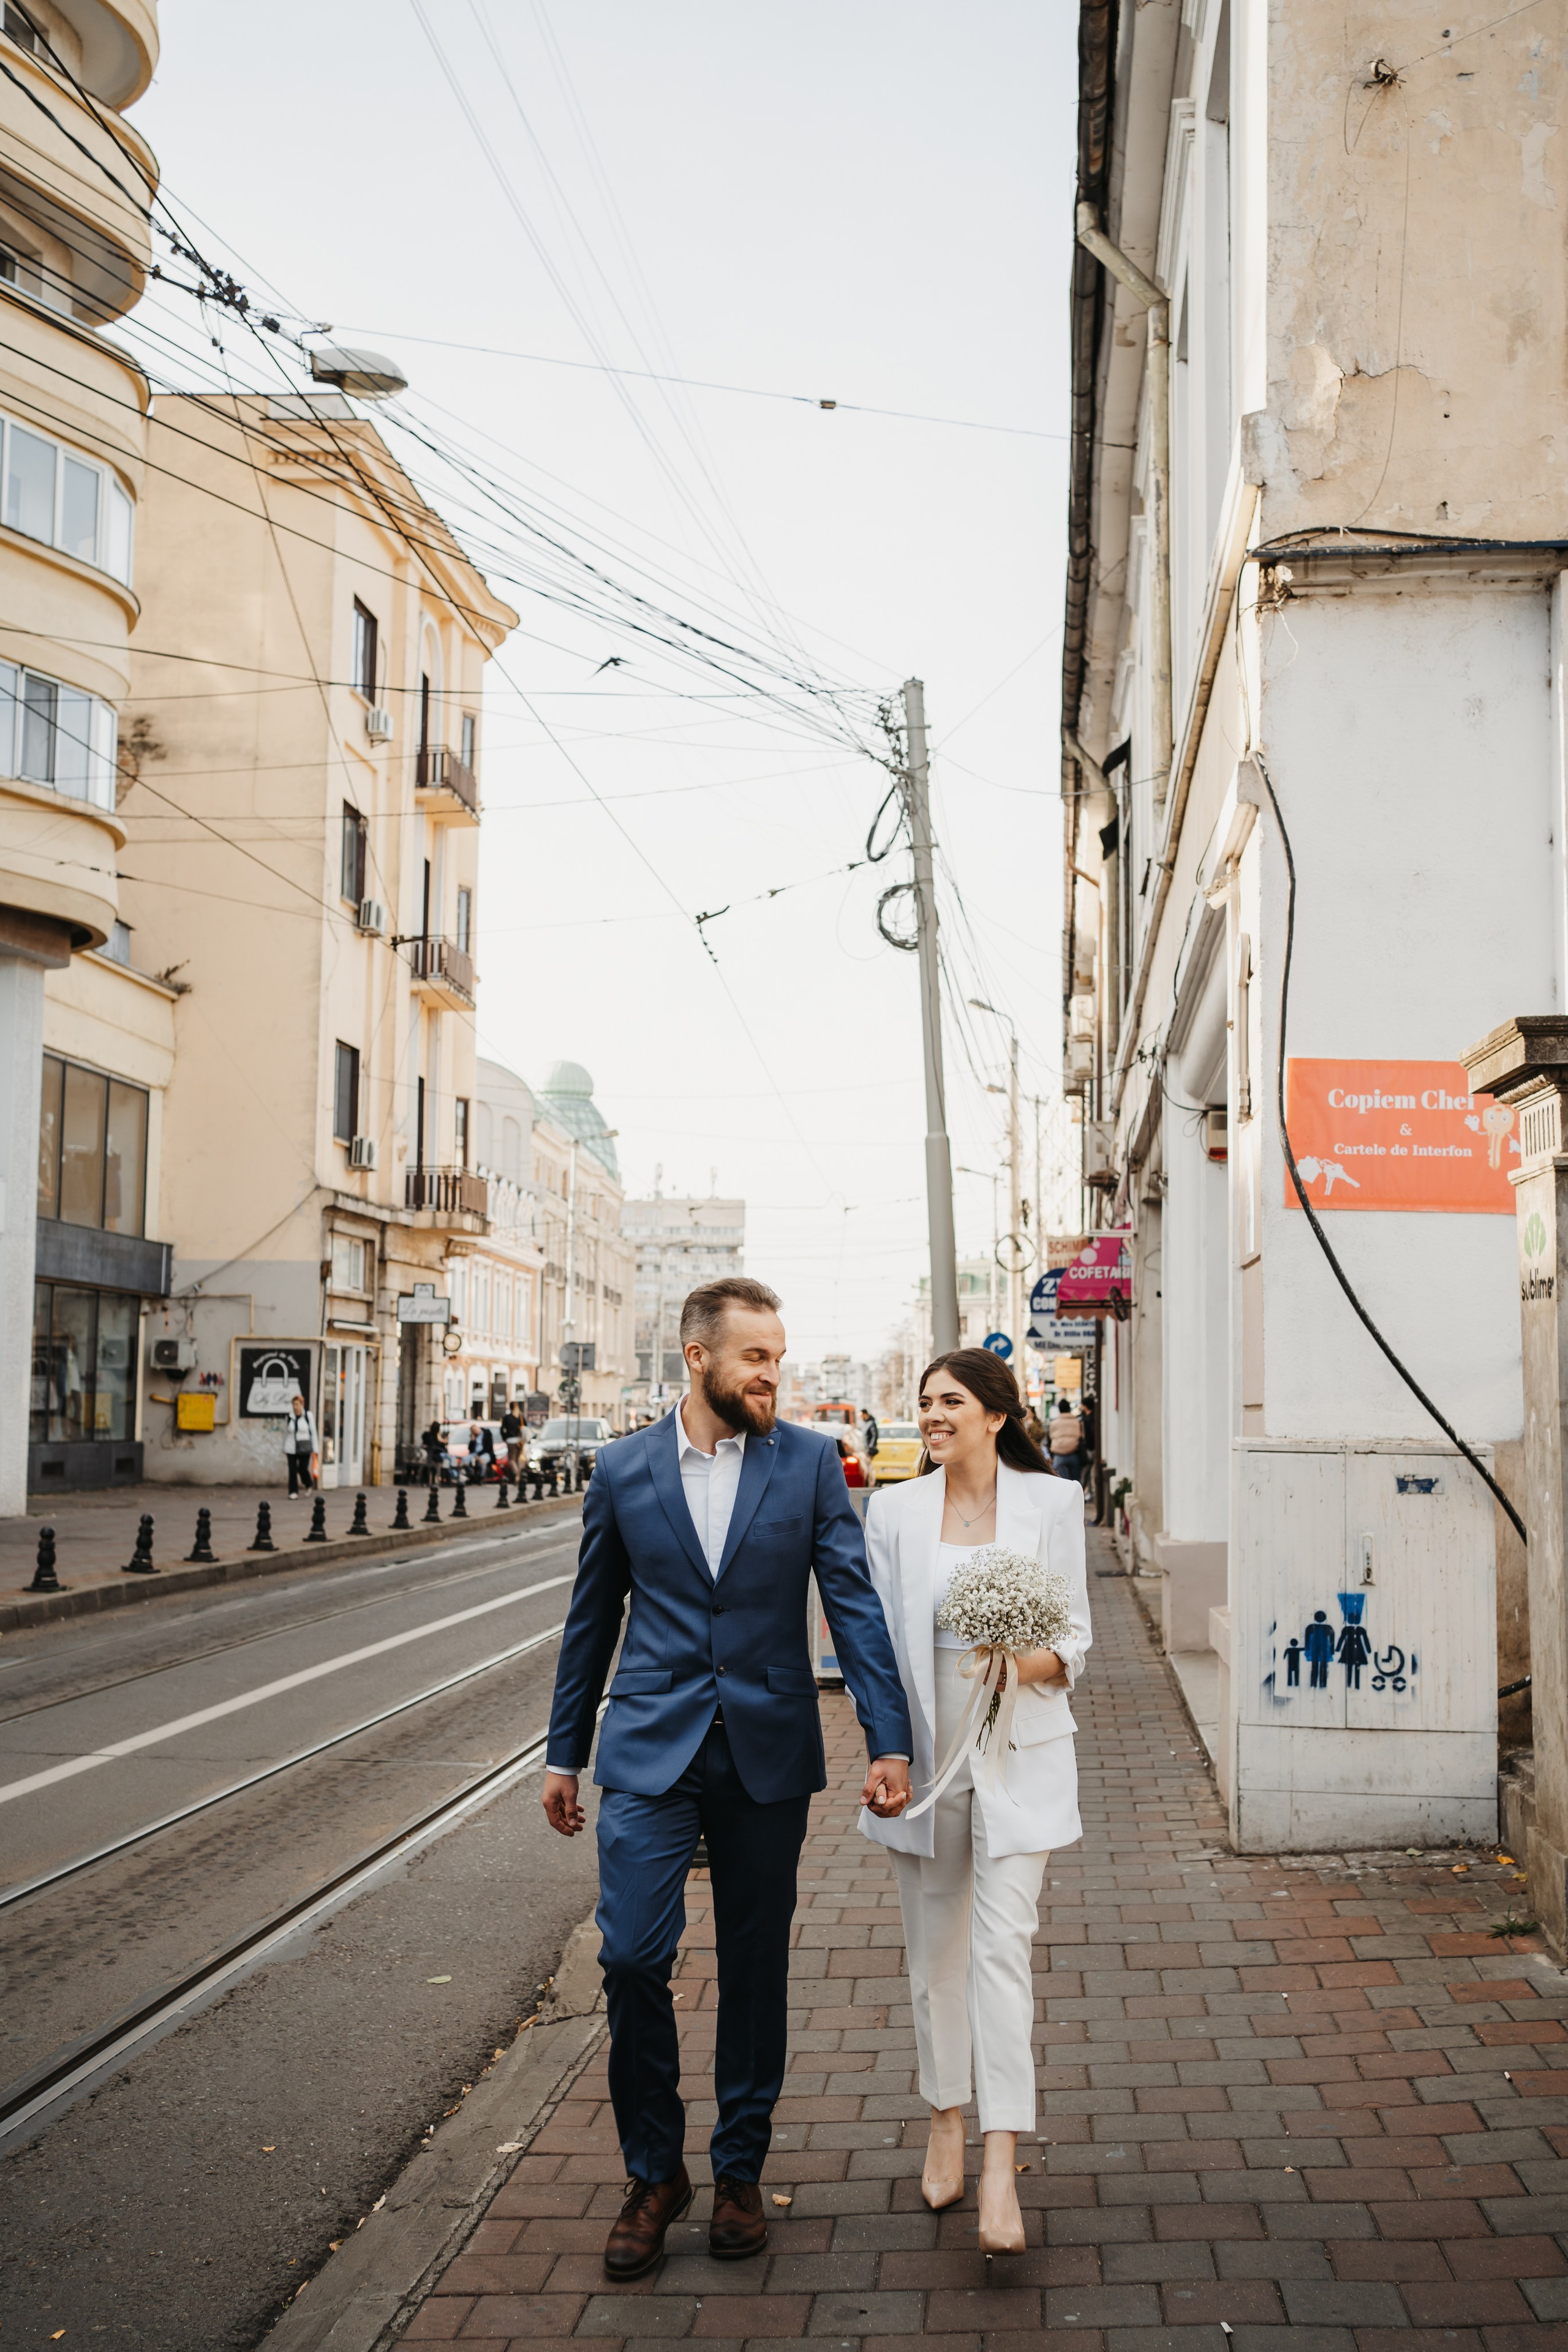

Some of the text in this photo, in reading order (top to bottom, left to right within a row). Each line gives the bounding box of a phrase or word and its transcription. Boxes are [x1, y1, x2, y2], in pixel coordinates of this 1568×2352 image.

[1328, 1088, 1475, 1114] Copiem Chei
[1400, 1123, 1412, 1136] &
[1333, 1143, 1472, 1158] Cartele de Interfon
